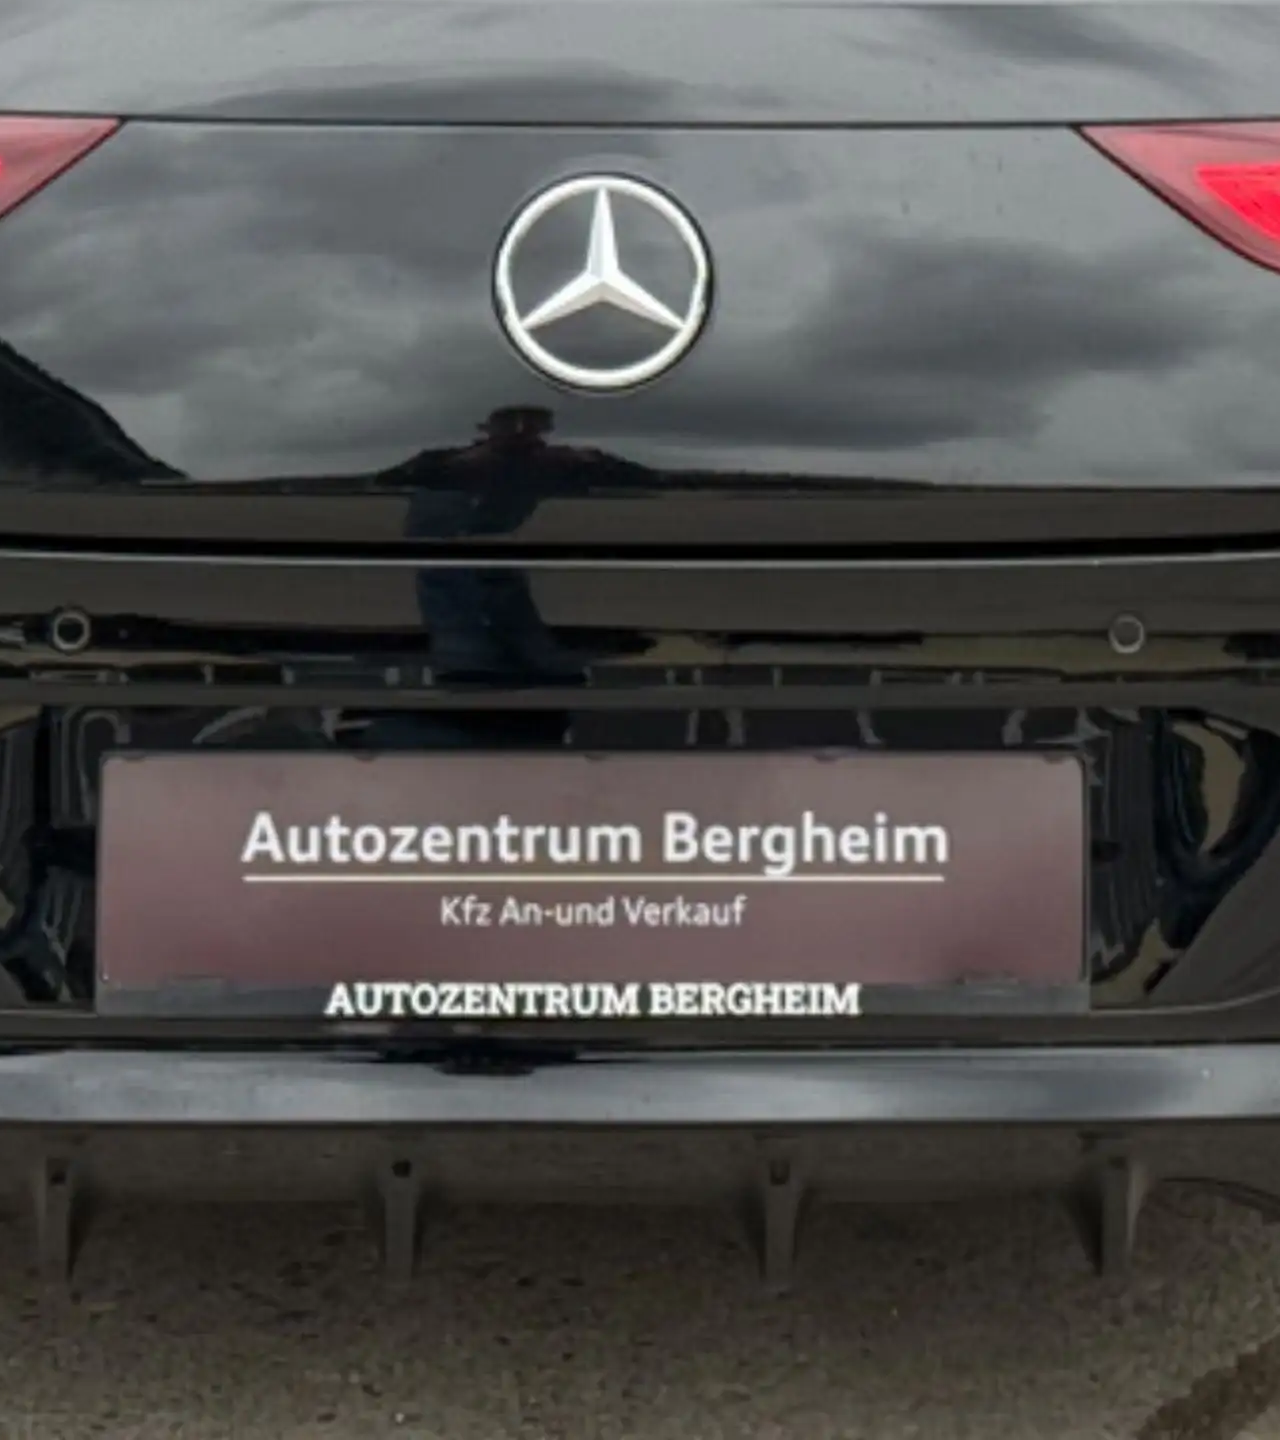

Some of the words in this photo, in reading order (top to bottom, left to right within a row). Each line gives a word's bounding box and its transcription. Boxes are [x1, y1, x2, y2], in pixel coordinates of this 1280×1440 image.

[241, 812, 641, 863] Autozentrum
[663, 811, 948, 875] Bergheim
[440, 896, 491, 926] Kfz
[499, 896, 615, 926] An-und
[622, 896, 746, 926] Verkauf
[324, 982, 640, 1016] AUTOZENTRUM
[649, 982, 860, 1016] BERGHEIM
